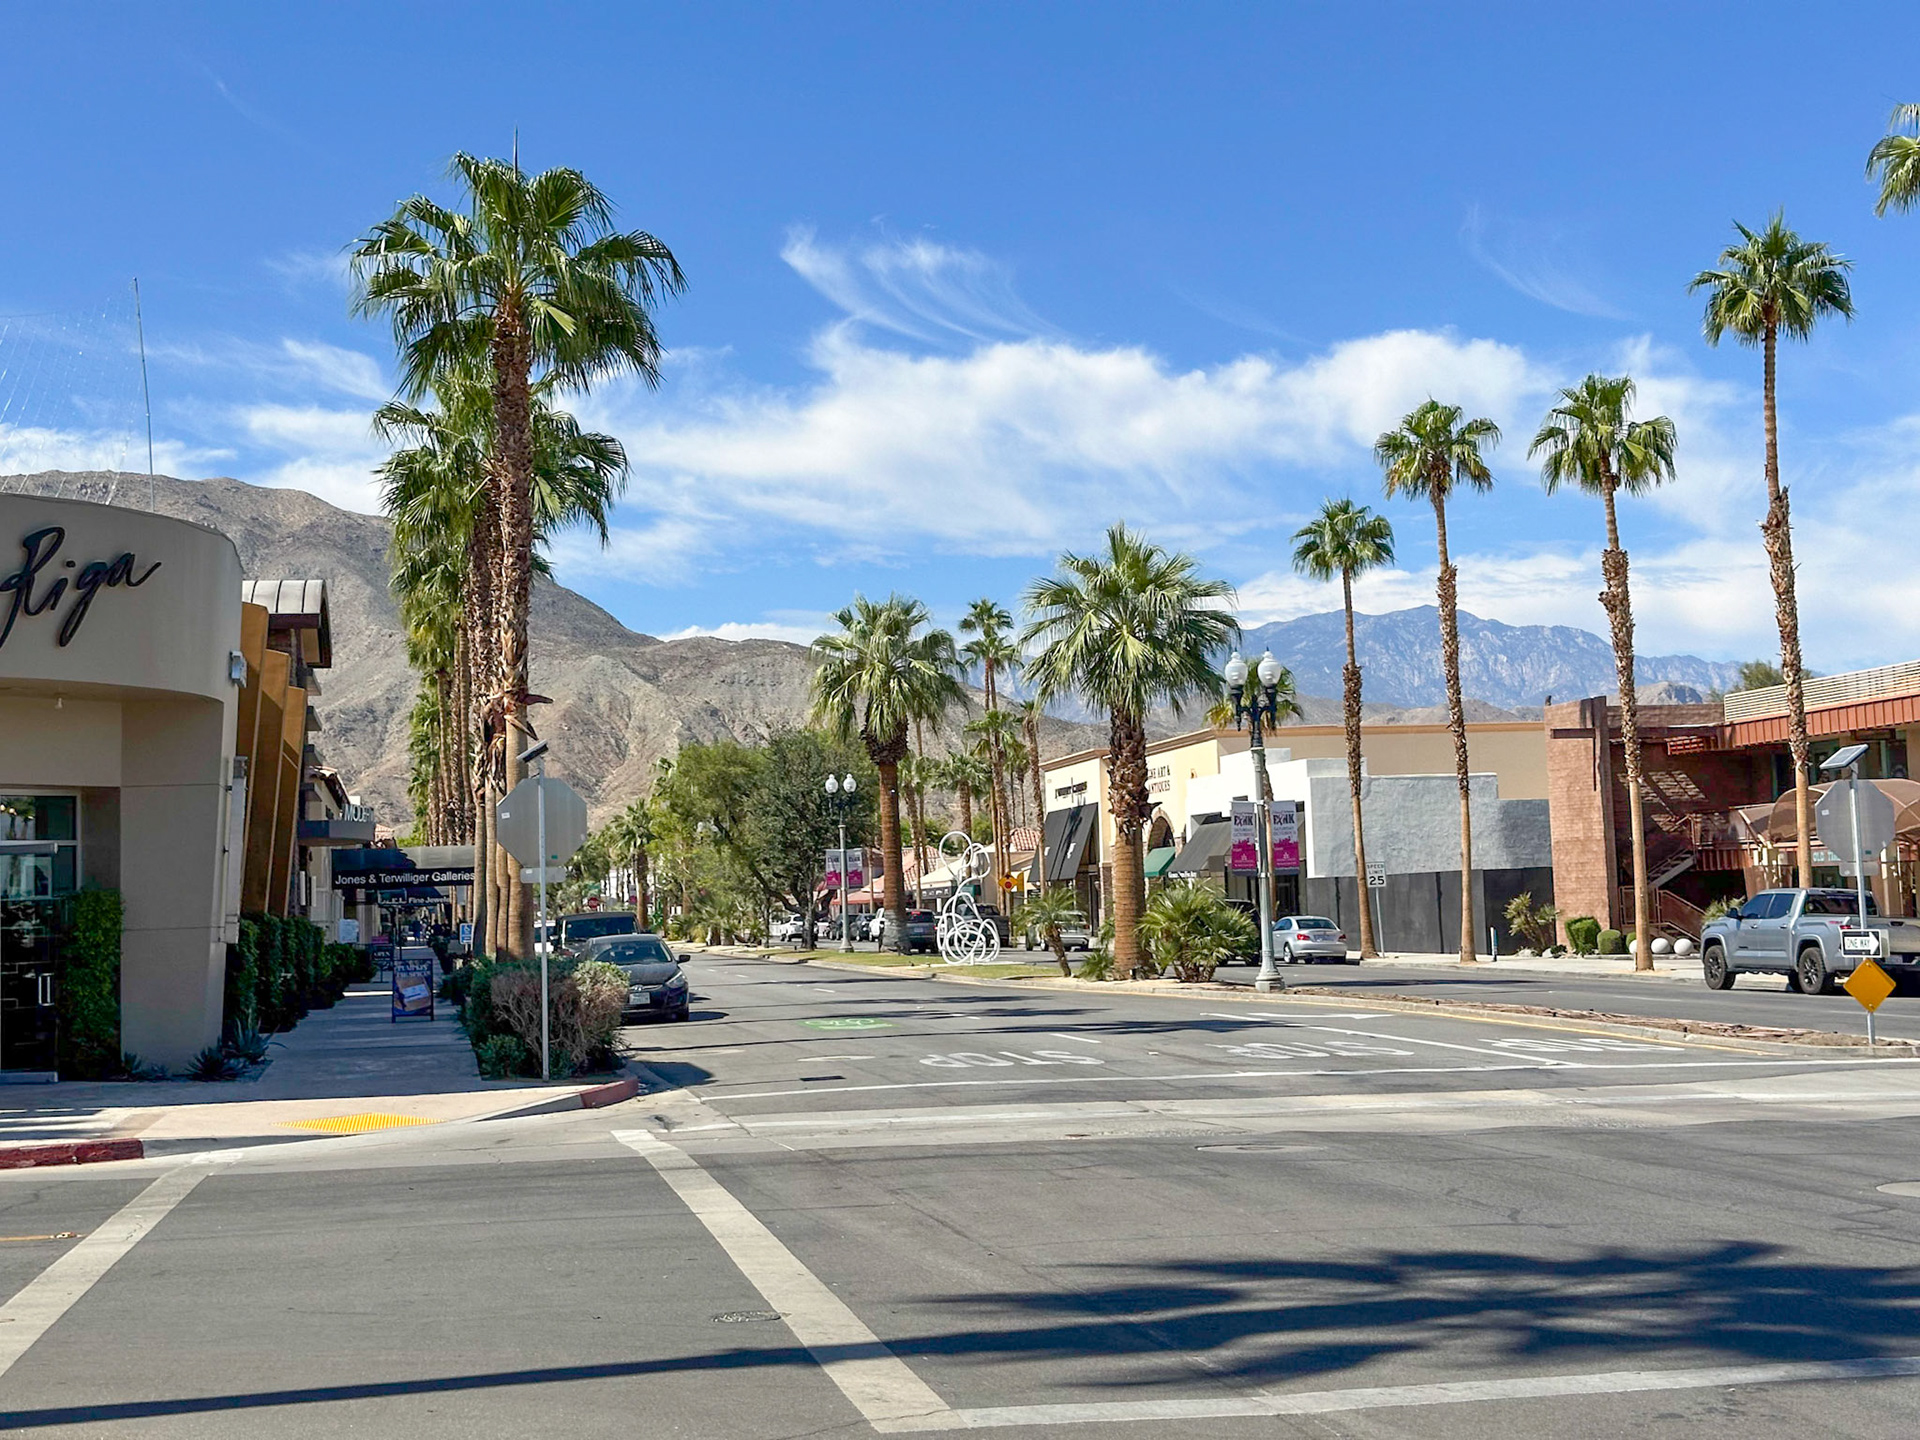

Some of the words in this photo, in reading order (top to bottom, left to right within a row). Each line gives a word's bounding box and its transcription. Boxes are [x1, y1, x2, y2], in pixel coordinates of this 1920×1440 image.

[335, 875, 367, 885] Jones
[368, 874, 377, 884] &
[379, 872, 430, 884] Terwilliger
[431, 871, 475, 882] Galleries
[1369, 876, 1385, 886] 25
[1847, 938, 1859, 949] ONE
[1860, 938, 1870, 948] WAY
[918, 1050, 1105, 1068] STOP
